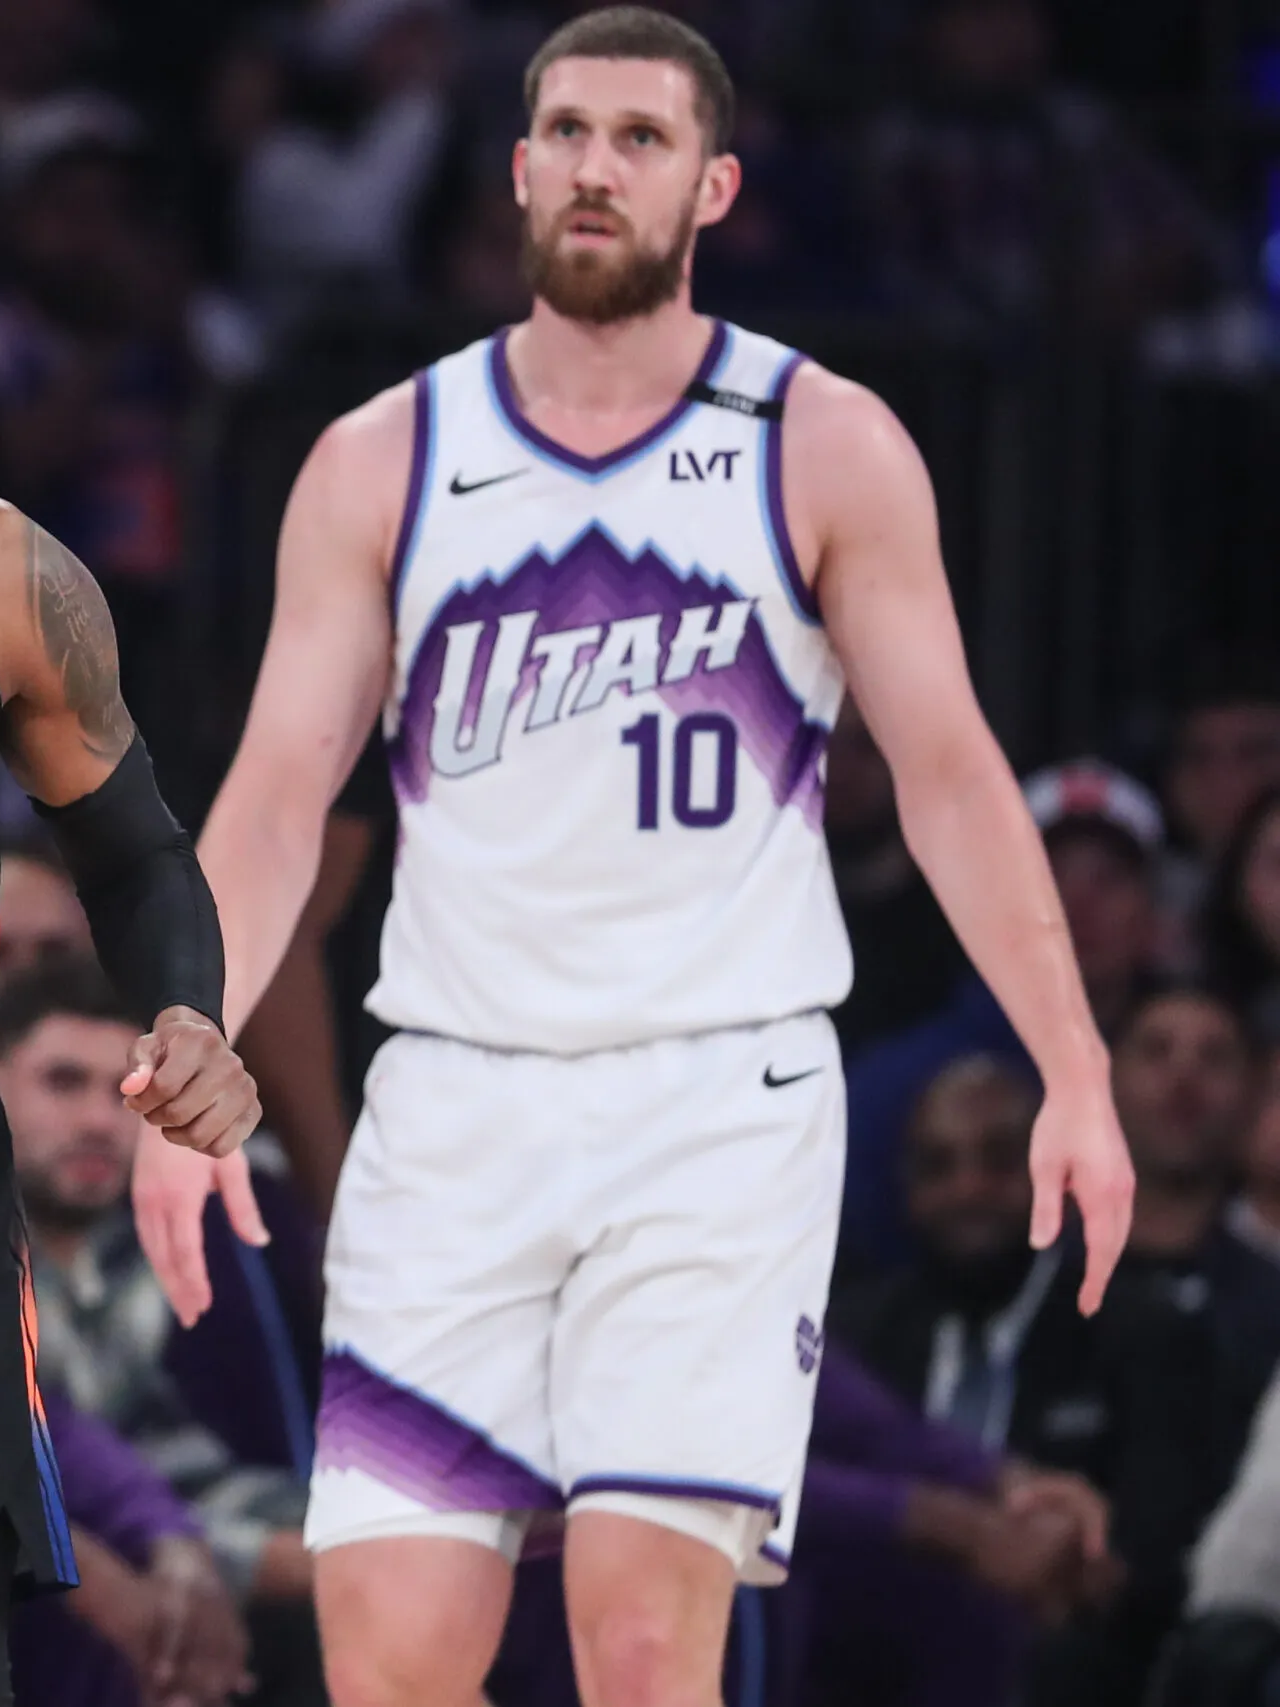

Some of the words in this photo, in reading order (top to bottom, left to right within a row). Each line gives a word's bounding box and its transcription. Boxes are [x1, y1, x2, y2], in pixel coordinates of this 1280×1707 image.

[669, 450, 742, 482] LVT
[429, 596, 760, 779] UTAH
[620, 711, 738, 830] 10
